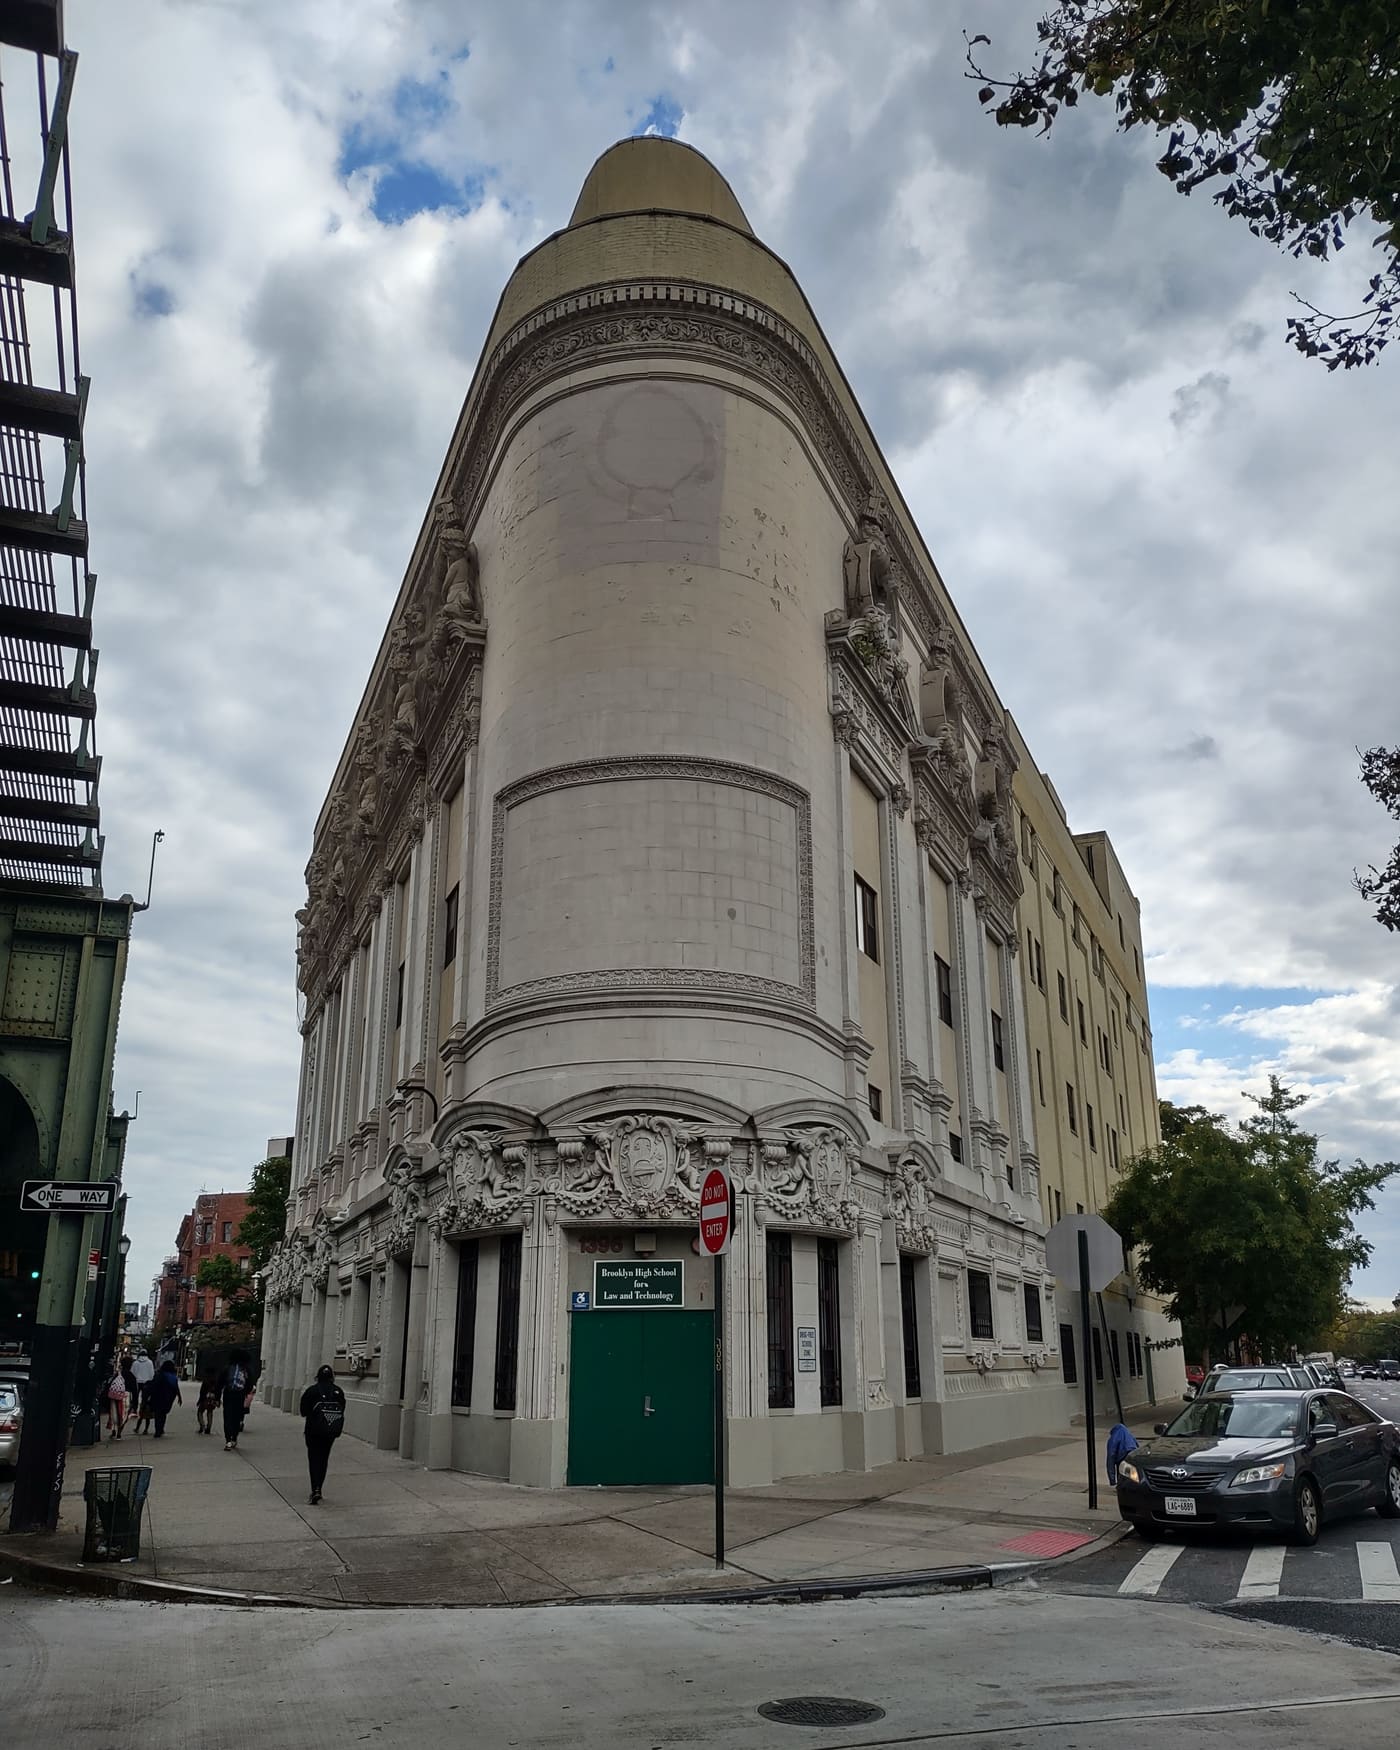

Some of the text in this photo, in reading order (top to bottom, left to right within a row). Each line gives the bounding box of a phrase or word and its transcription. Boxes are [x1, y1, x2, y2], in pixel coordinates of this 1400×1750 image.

[37, 1190, 105, 1203] ONE WAY
[704, 1184, 724, 1200] DO NOT
[706, 1222, 723, 1238] ENTER
[601, 1267, 677, 1279] Brooklyn High School
[603, 1290, 674, 1302] Law and Technology
